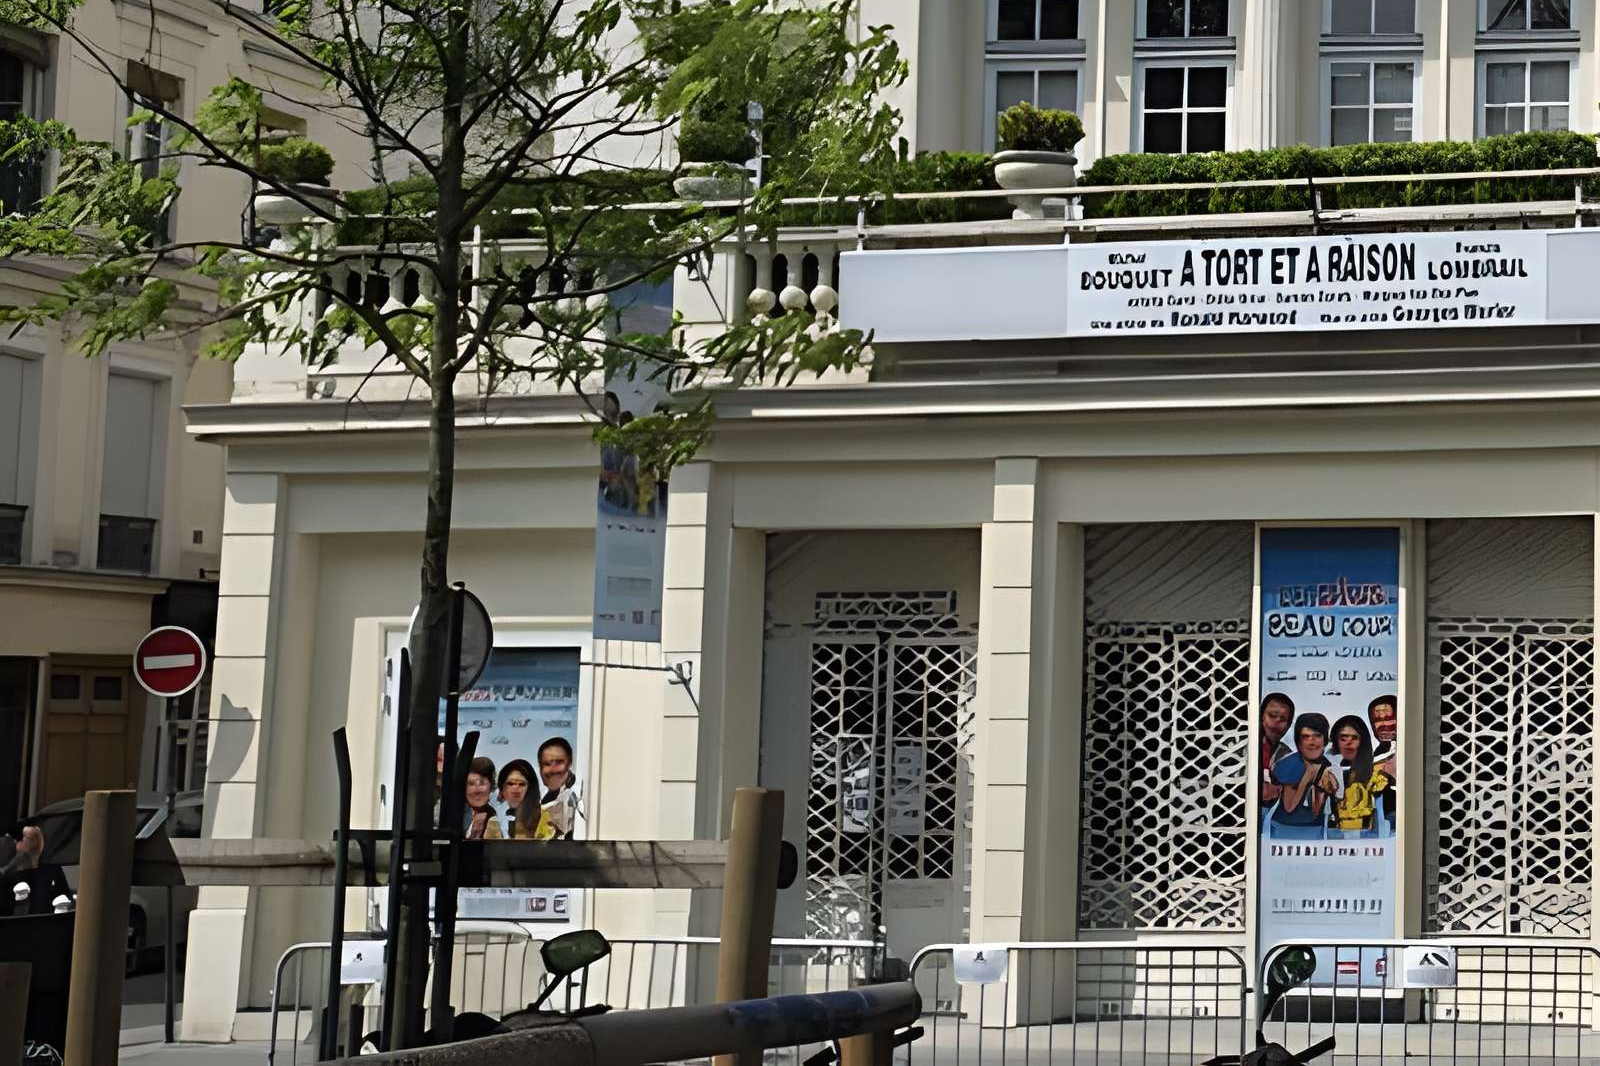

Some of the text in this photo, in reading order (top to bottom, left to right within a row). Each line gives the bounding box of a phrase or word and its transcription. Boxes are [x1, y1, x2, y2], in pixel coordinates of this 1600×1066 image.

[1180, 249, 1195, 287] A
[1200, 247, 1264, 286] TORT
[1270, 247, 1301, 285] ET
[1305, 245, 1321, 283] A
[1327, 242, 1416, 283] RAISON
